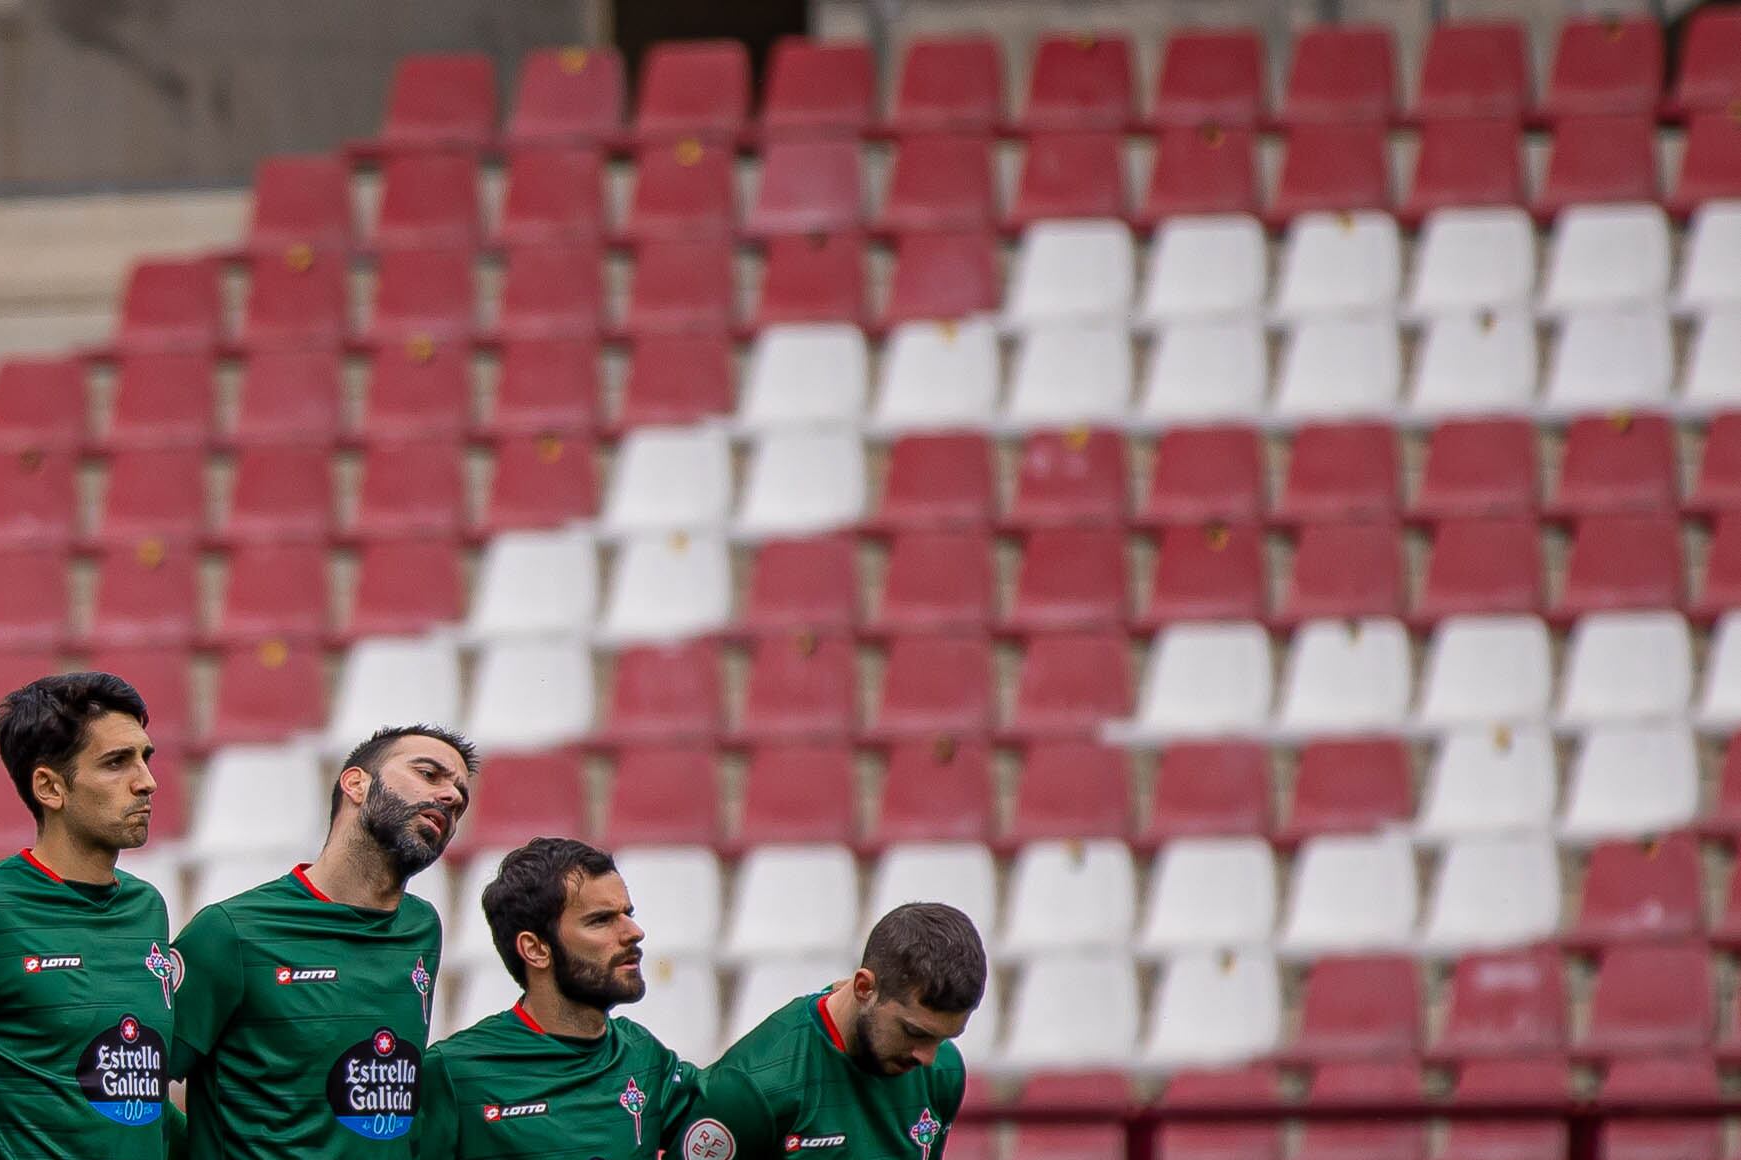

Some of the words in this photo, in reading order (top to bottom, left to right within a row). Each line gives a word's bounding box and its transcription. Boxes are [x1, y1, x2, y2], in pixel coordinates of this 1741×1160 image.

[41, 957, 81, 968] LOTTO
[292, 970, 337, 980] LOTTO
[96, 1045, 160, 1071] Estrella
[345, 1058, 417, 1084] Estrella
[102, 1071, 160, 1097] Galicia
[124, 1098, 144, 1121] 0,0
[350, 1084, 413, 1112] Galicia
[501, 1103, 547, 1117] LOTTO
[373, 1112, 397, 1136] 0,0
[800, 1136, 846, 1147] LOTTO
